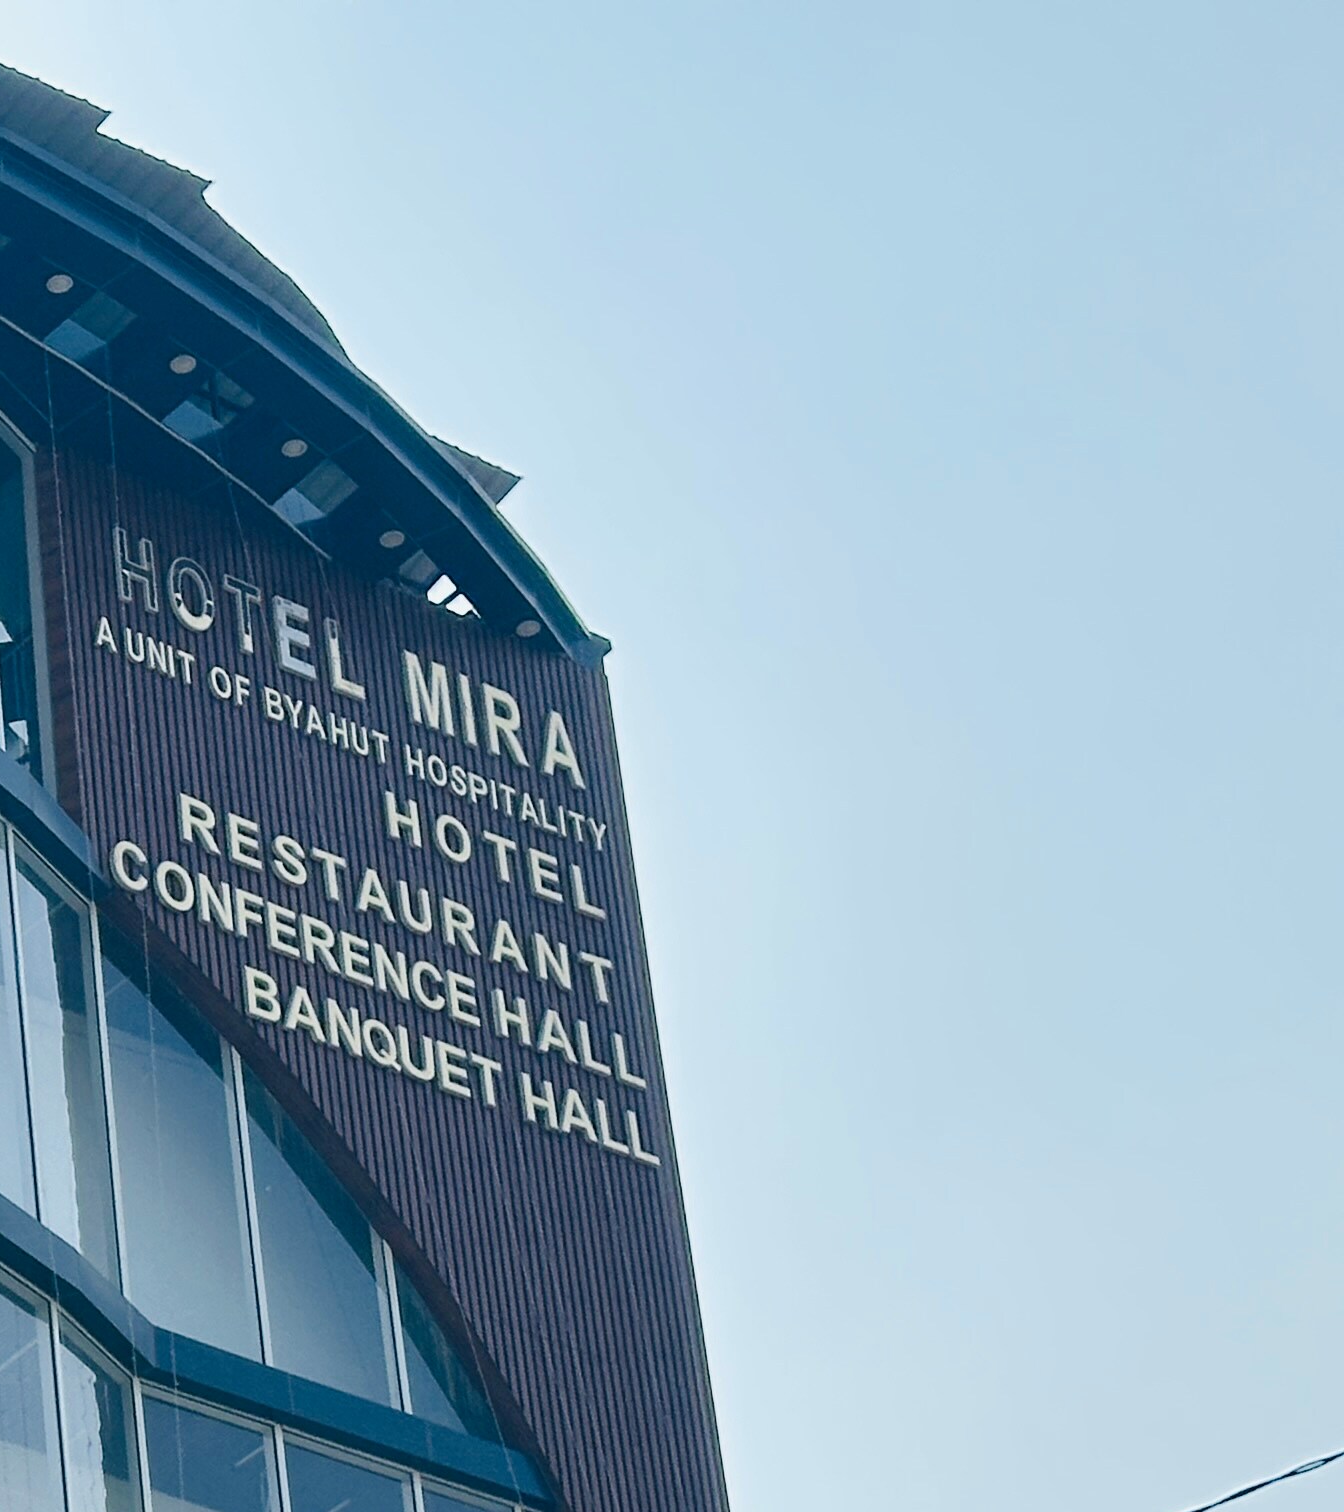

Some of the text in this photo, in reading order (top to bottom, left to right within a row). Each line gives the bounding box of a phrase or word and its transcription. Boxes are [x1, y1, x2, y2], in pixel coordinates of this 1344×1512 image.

[96, 616, 607, 851] A UNIT OF BYAHUT HOSPITALITY
[112, 526, 586, 789] HOTEL MIRA
[112, 840, 646, 1089] CONFERENCE HALL
[178, 793, 612, 1003] RESTAURANT
[385, 790, 607, 920] HOTEL
[244, 966, 661, 1167] BANQUET HALL
